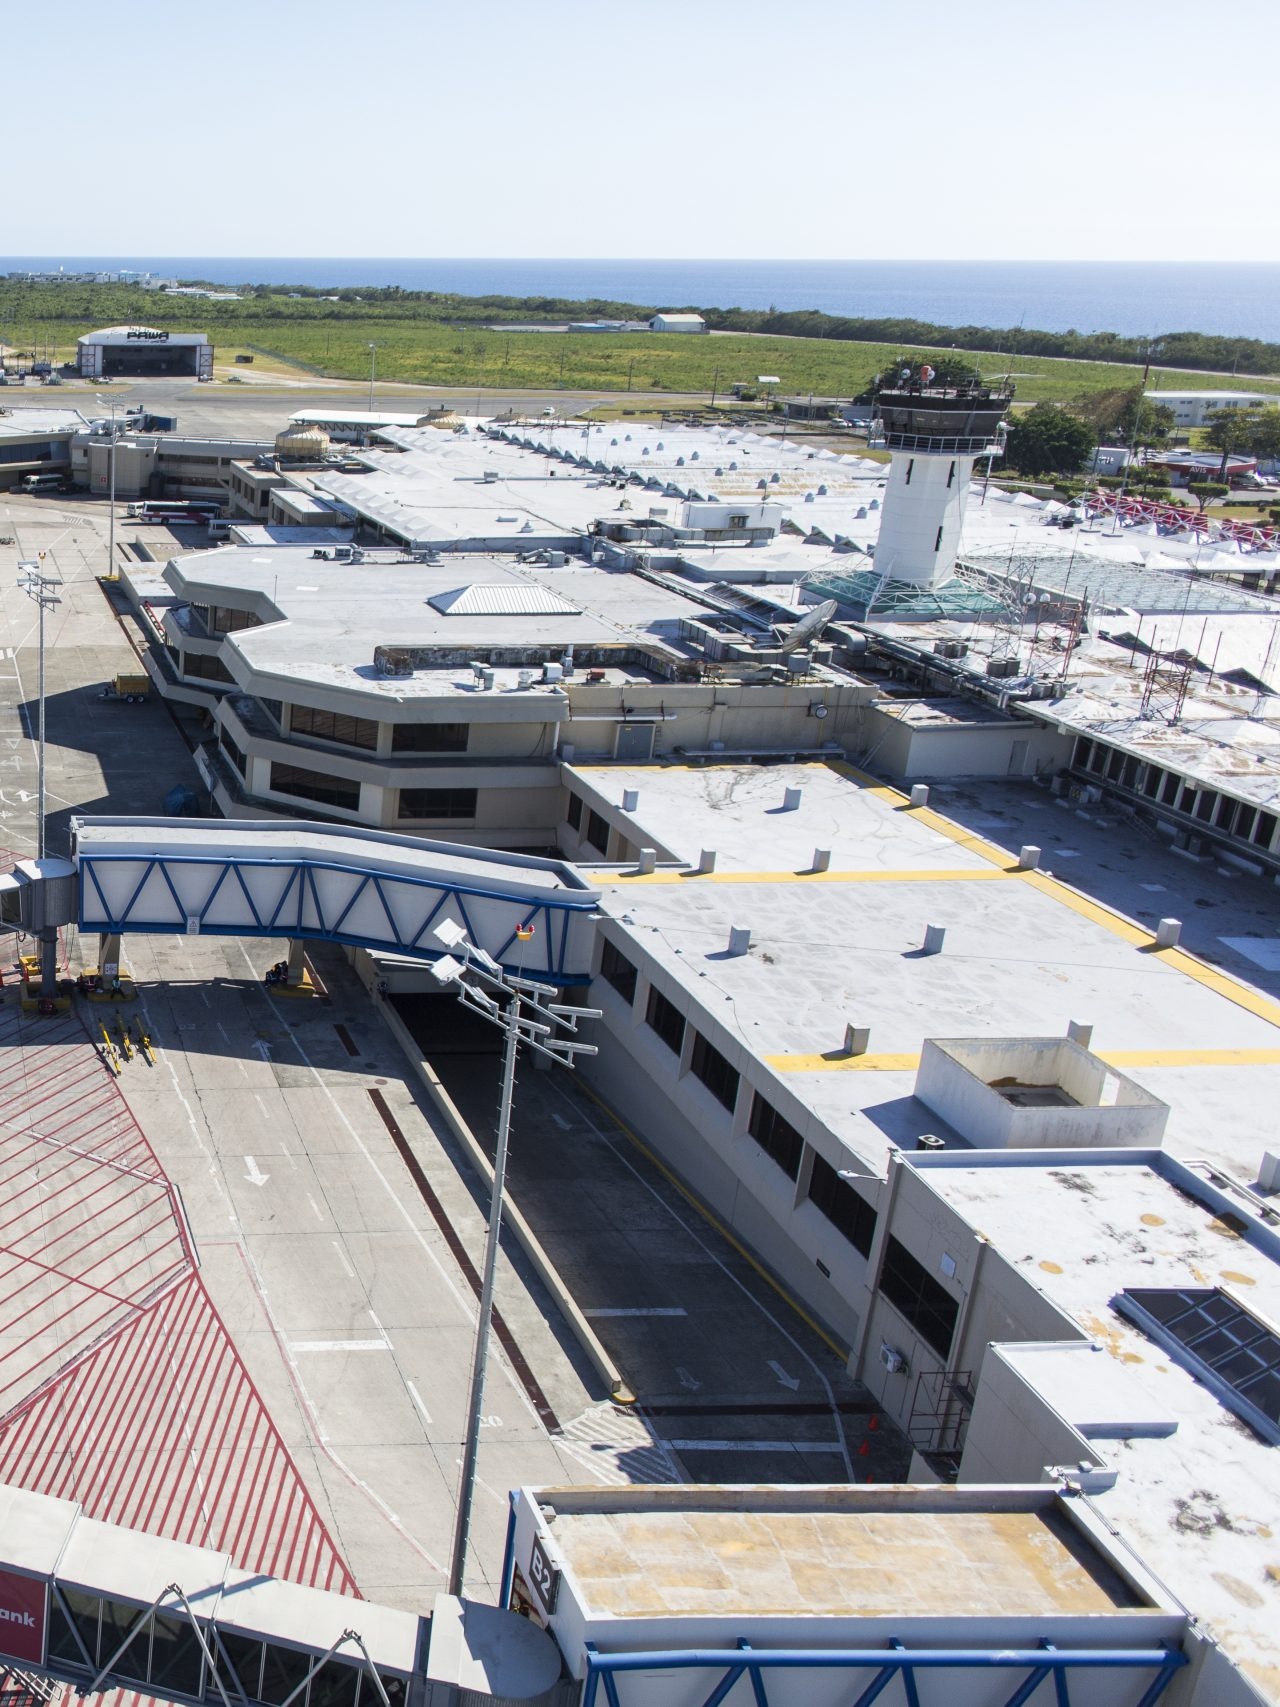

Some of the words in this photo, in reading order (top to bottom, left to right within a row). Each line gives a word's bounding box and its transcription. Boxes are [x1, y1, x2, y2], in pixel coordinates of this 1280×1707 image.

[127, 331, 169, 340] PAWA
[1189, 466, 1208, 474] AVIS
[531, 1546, 551, 1600] B2
